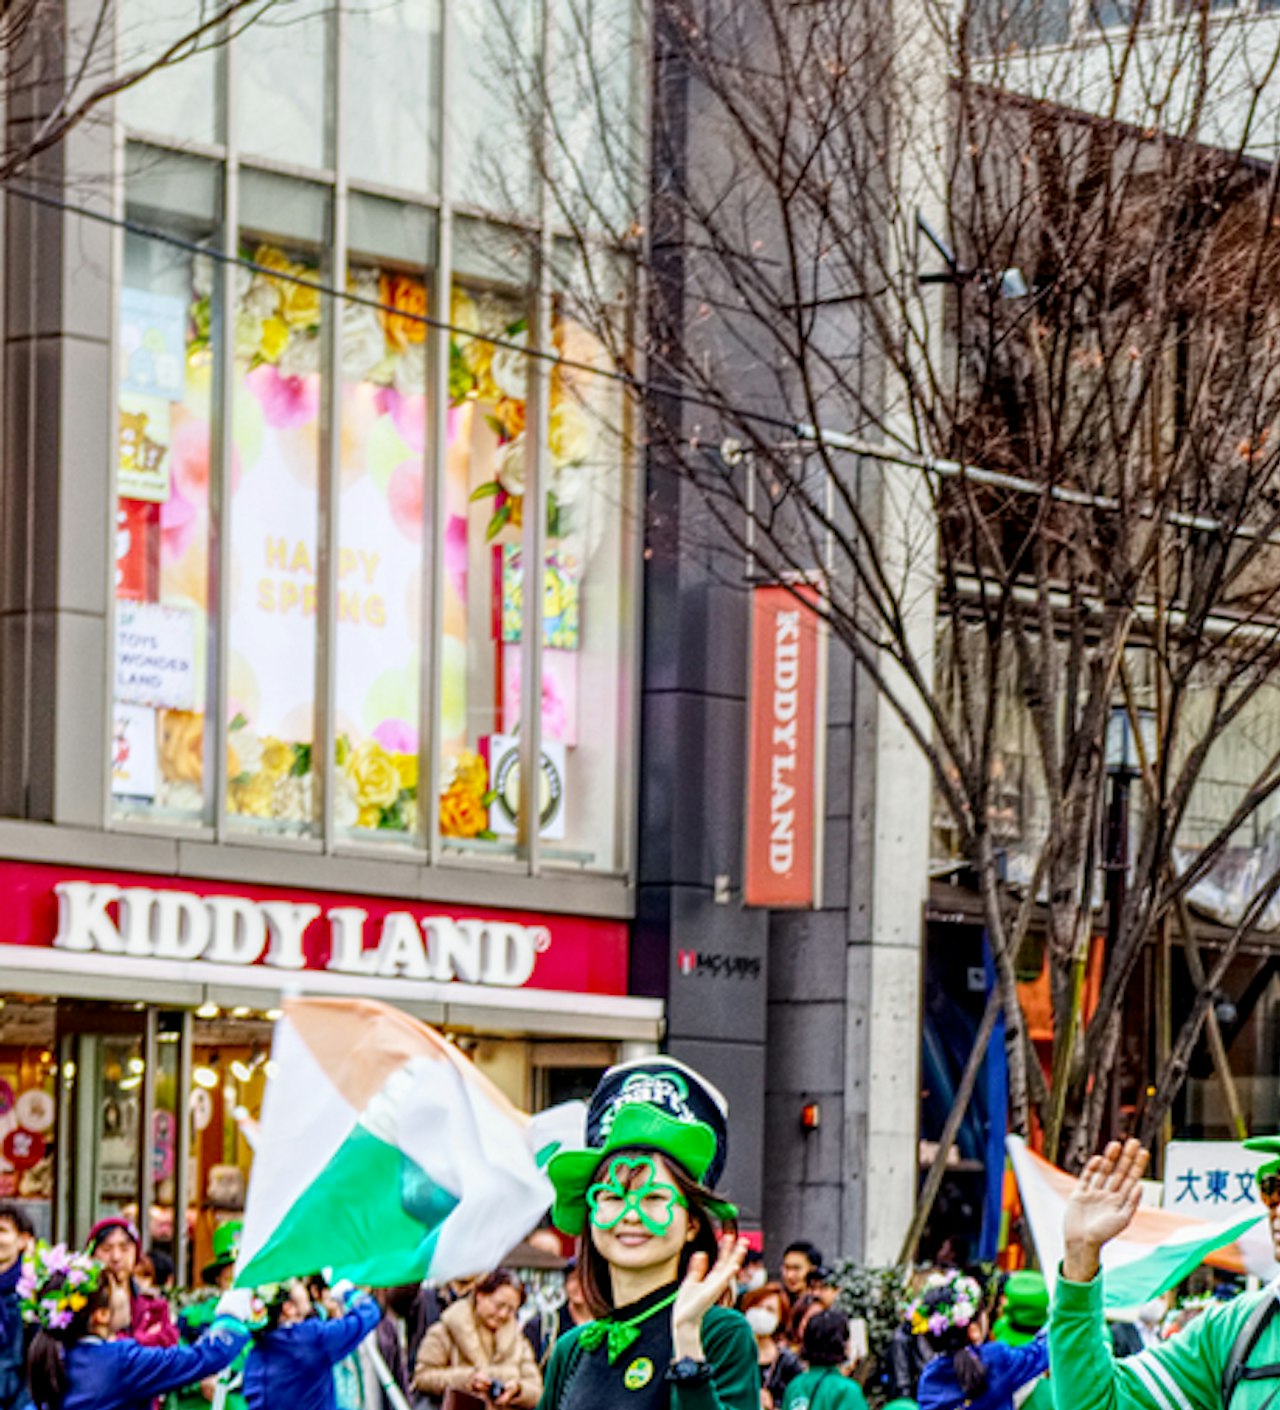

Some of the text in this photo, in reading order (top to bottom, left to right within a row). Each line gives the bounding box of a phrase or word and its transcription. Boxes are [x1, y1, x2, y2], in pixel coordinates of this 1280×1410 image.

[265, 535, 380, 584] HAPY
[257, 577, 386, 629] SPRNG
[769, 610, 801, 876] KIDDY LAND
[53, 881, 536, 987] KIDDY LAND
